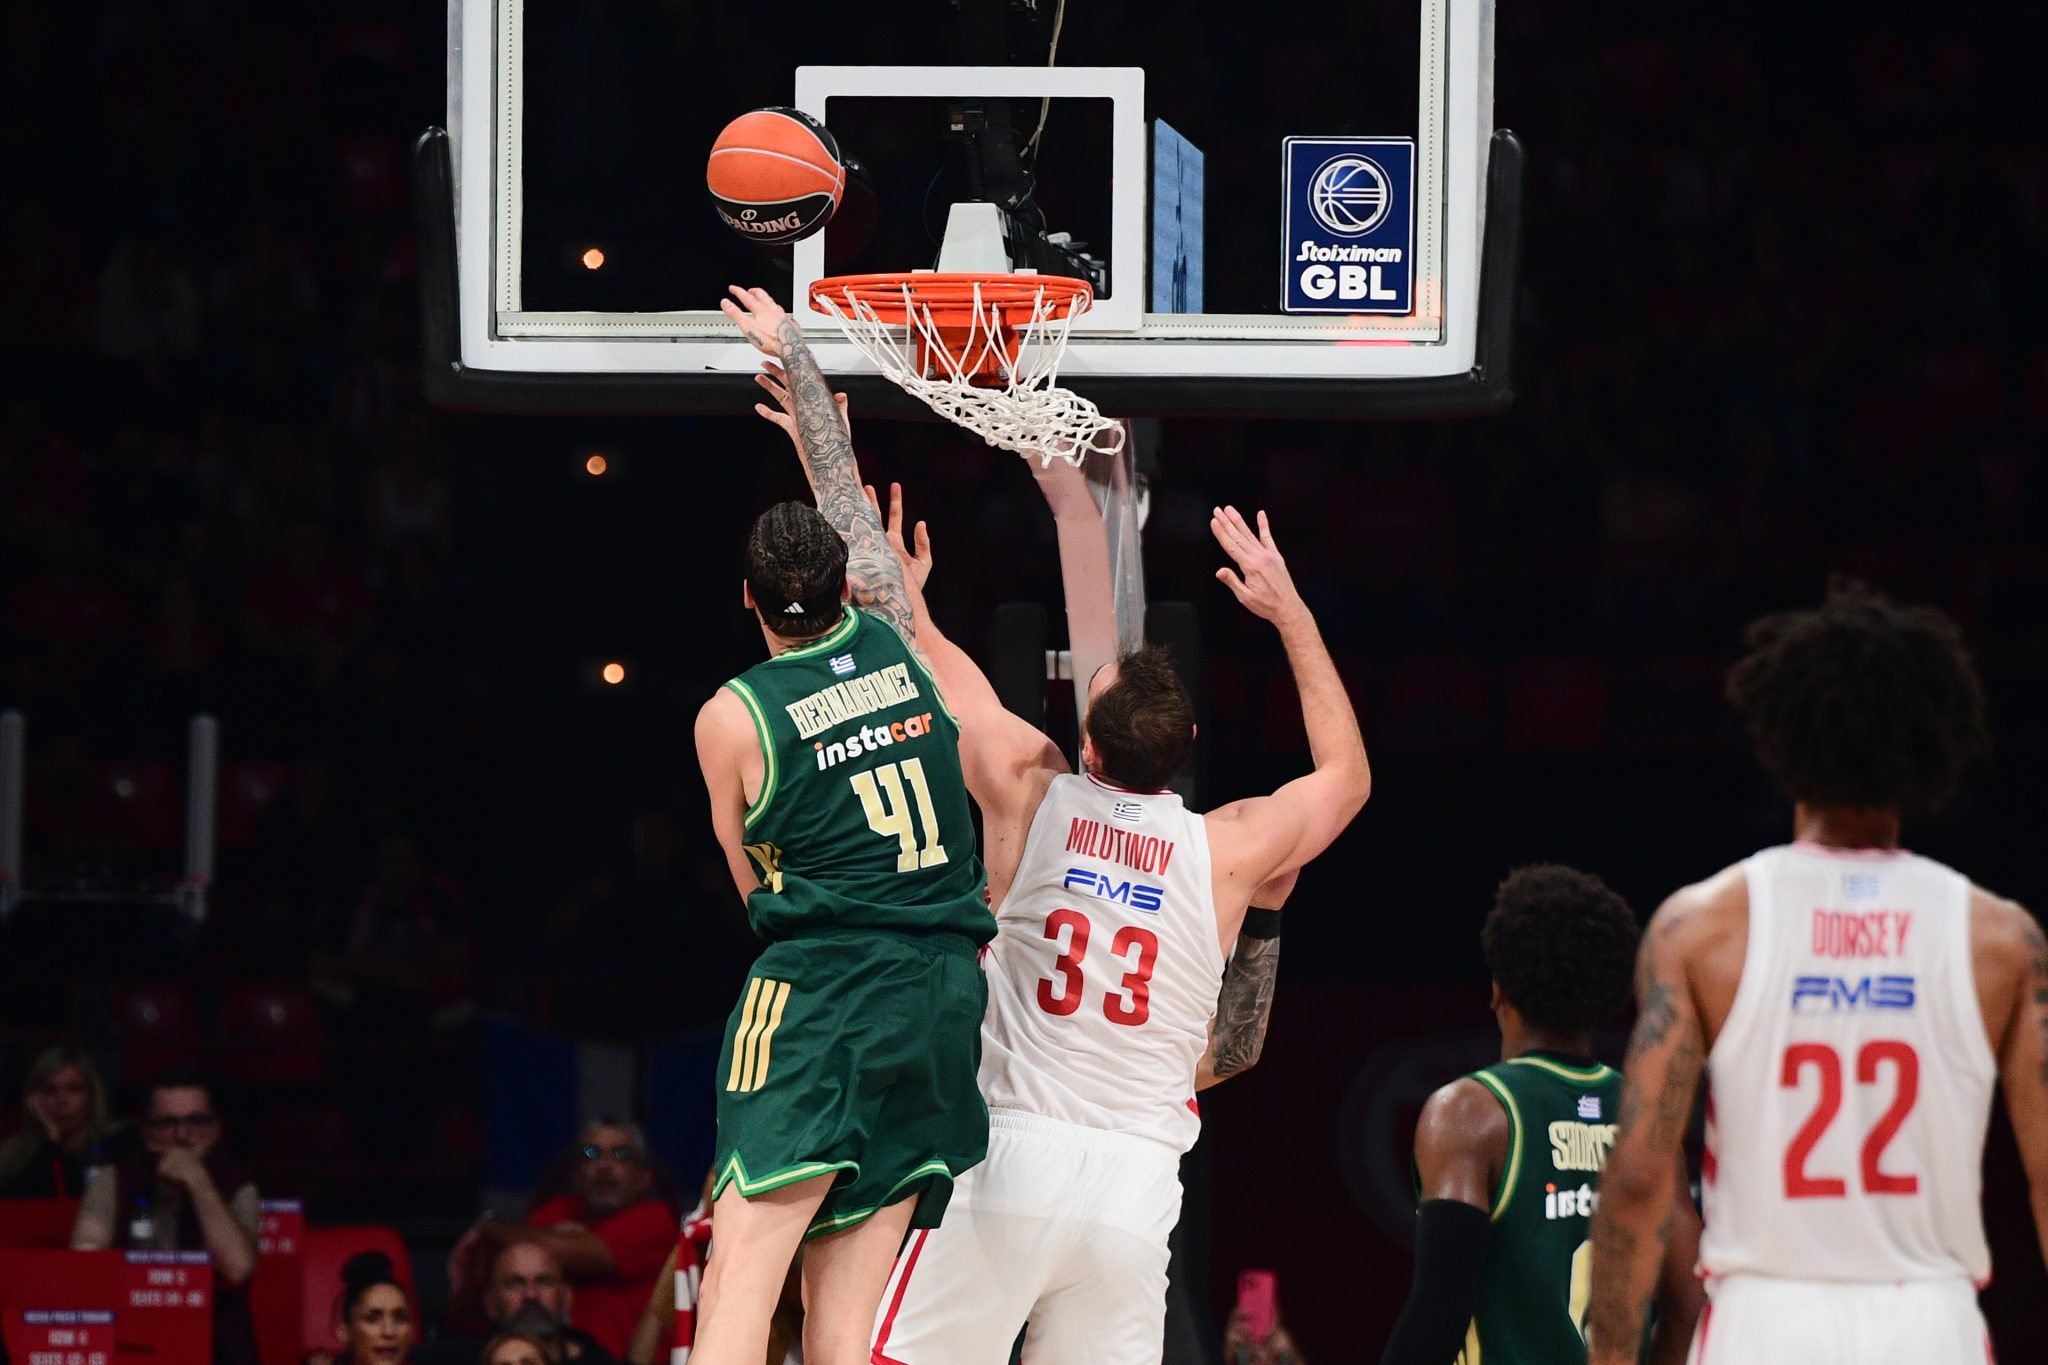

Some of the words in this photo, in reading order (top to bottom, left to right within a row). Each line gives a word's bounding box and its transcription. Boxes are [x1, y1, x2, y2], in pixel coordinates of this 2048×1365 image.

[716, 206, 802, 234] SPALDING
[1296, 240, 1402, 262] Stoiximan
[1300, 264, 1397, 301] GBL
[785, 662, 920, 740] HERNANGOMEZ
[814, 712, 932, 771] instacar
[849, 757, 949, 873] 41
[1065, 817, 1175, 876] MILUTINOV
[1064, 868, 1164, 911] FMS
[1812, 909, 1914, 959] DORSEY
[1037, 908, 1158, 1026] 33
[1792, 975, 1916, 1010] FMS
[1780, 1039, 1919, 1199] 22
